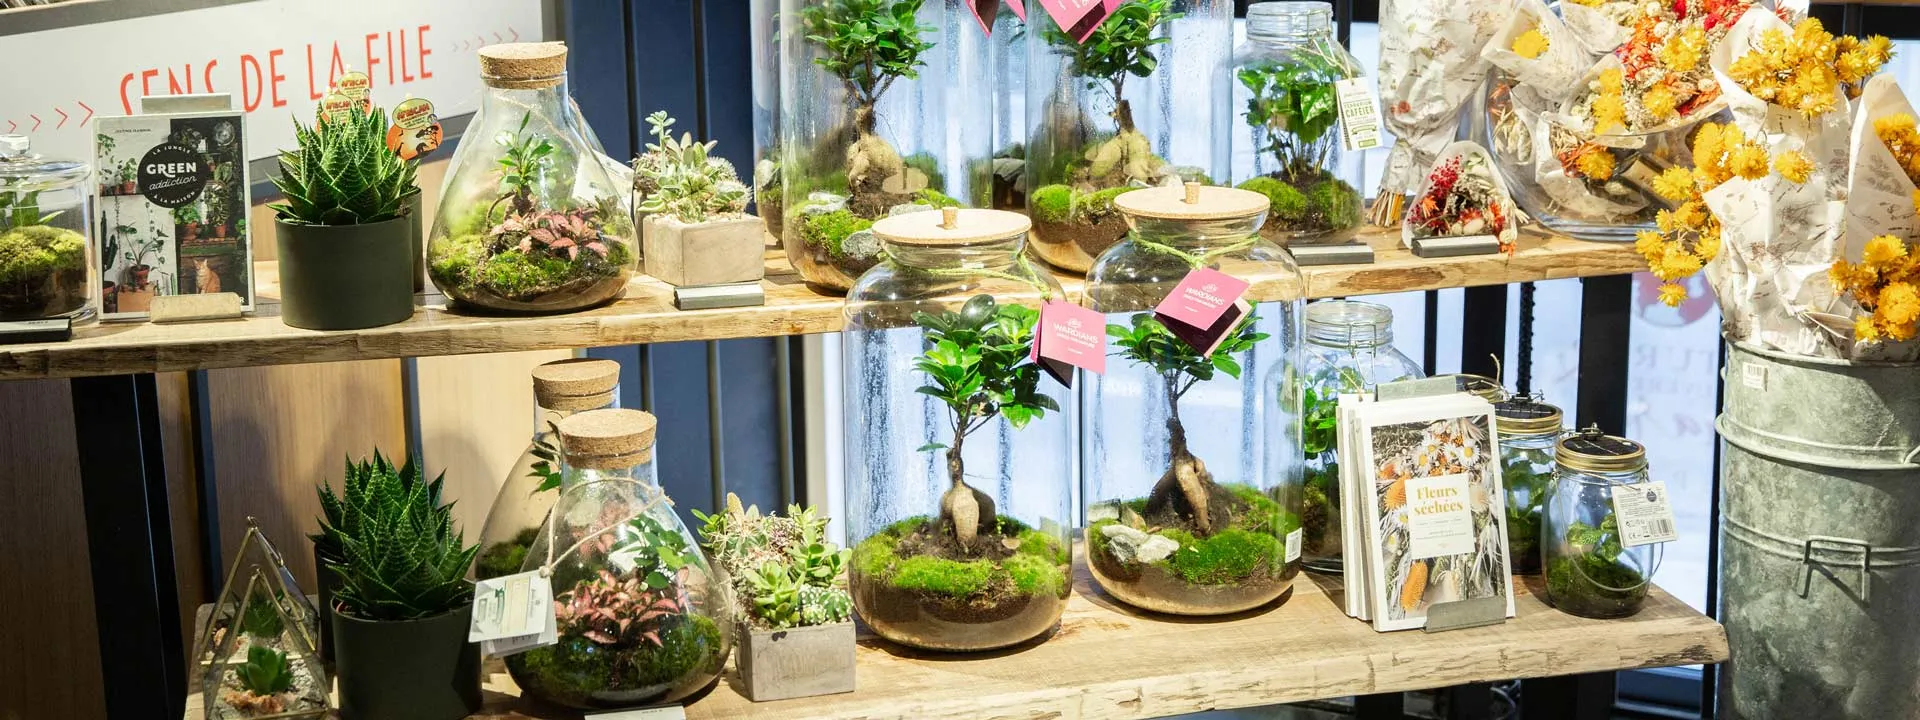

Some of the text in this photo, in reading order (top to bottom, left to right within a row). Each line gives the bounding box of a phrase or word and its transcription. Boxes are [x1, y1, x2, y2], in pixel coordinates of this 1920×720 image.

[240, 49, 287, 113] DE
[306, 40, 346, 101] LA
[365, 25, 433, 89] FILE
[164, 145, 191, 154] JUNGLE
[146, 162, 196, 178] GREEN
[149, 175, 197, 190] addiction
[170, 191, 195, 203] MAISON
[1053, 322, 1098, 344] WARDIANS
[1417, 486, 1458, 500] Fleurs
